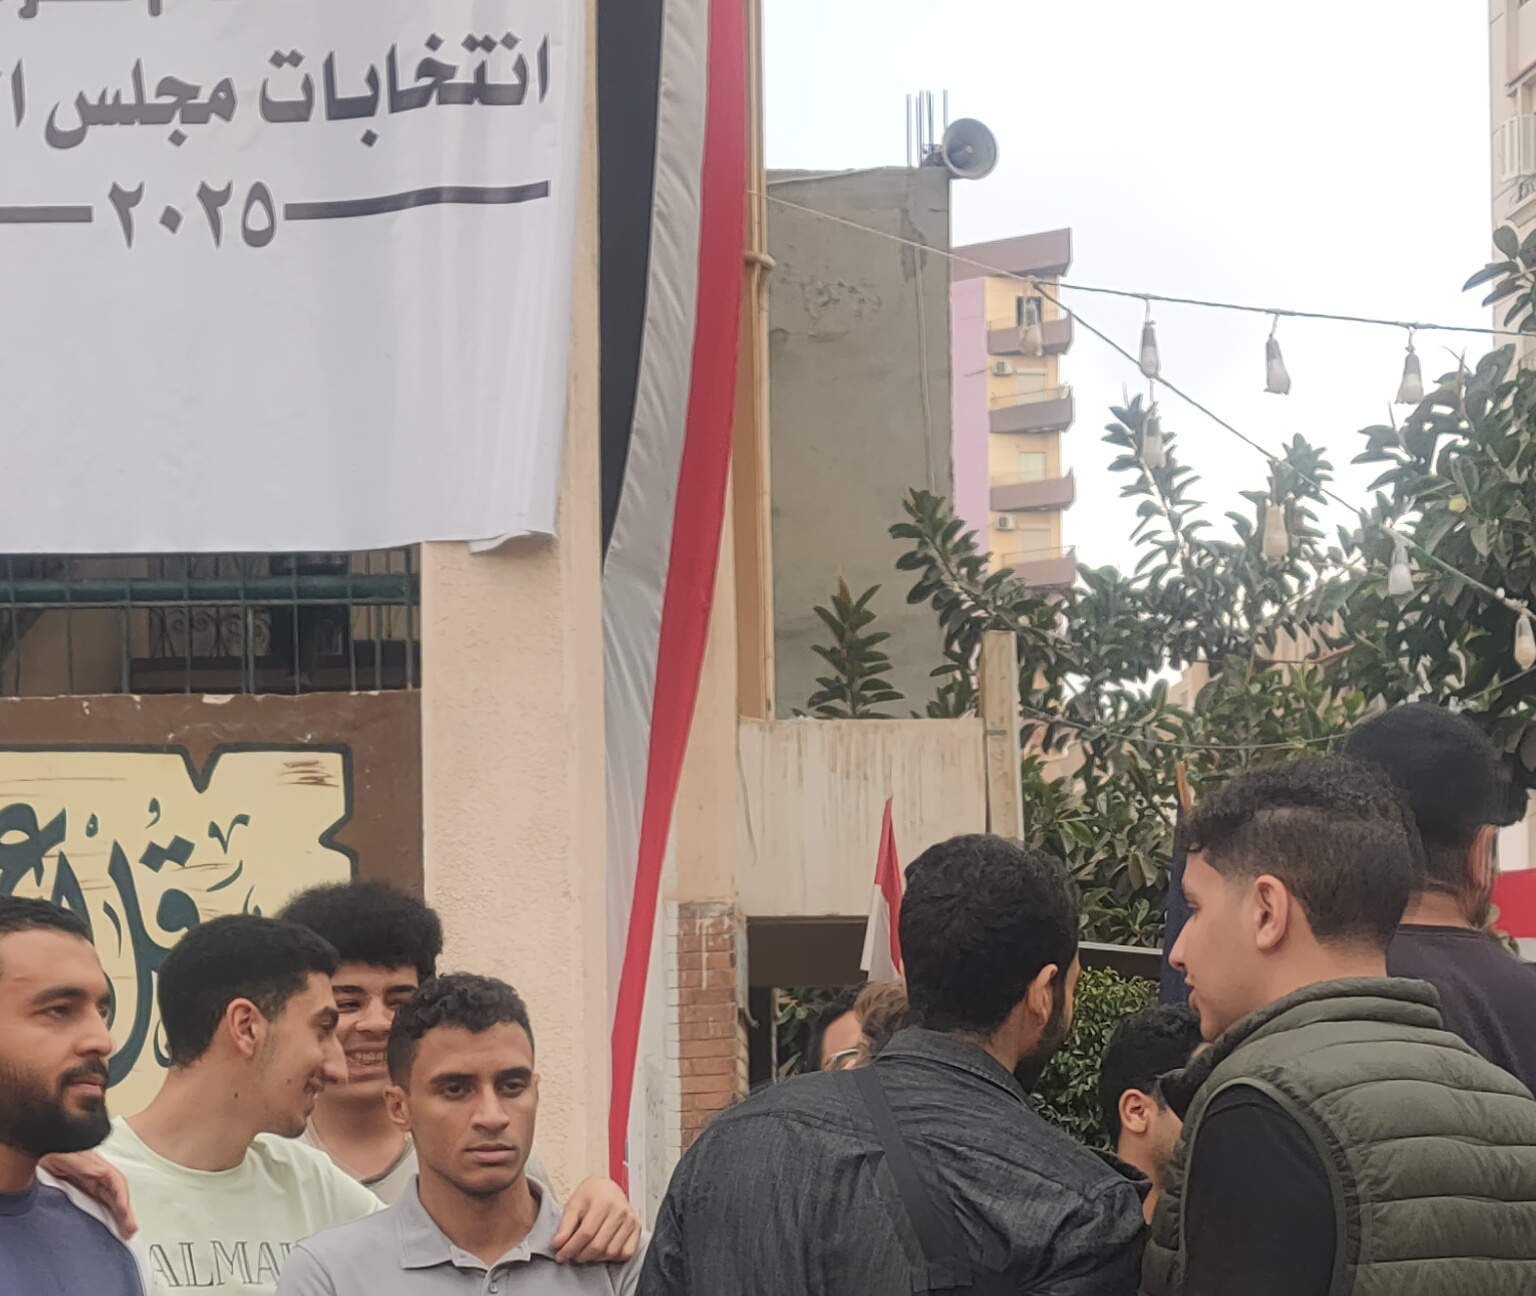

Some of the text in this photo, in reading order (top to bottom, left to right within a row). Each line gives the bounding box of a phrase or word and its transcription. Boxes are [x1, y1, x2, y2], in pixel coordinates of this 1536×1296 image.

[43, 58, 238, 151] مجلس
[258, 31, 549, 149] انتخابات
[107, 180, 277, 249] ٢٠٢٥
[149, 1240, 292, 1288] ALMA
